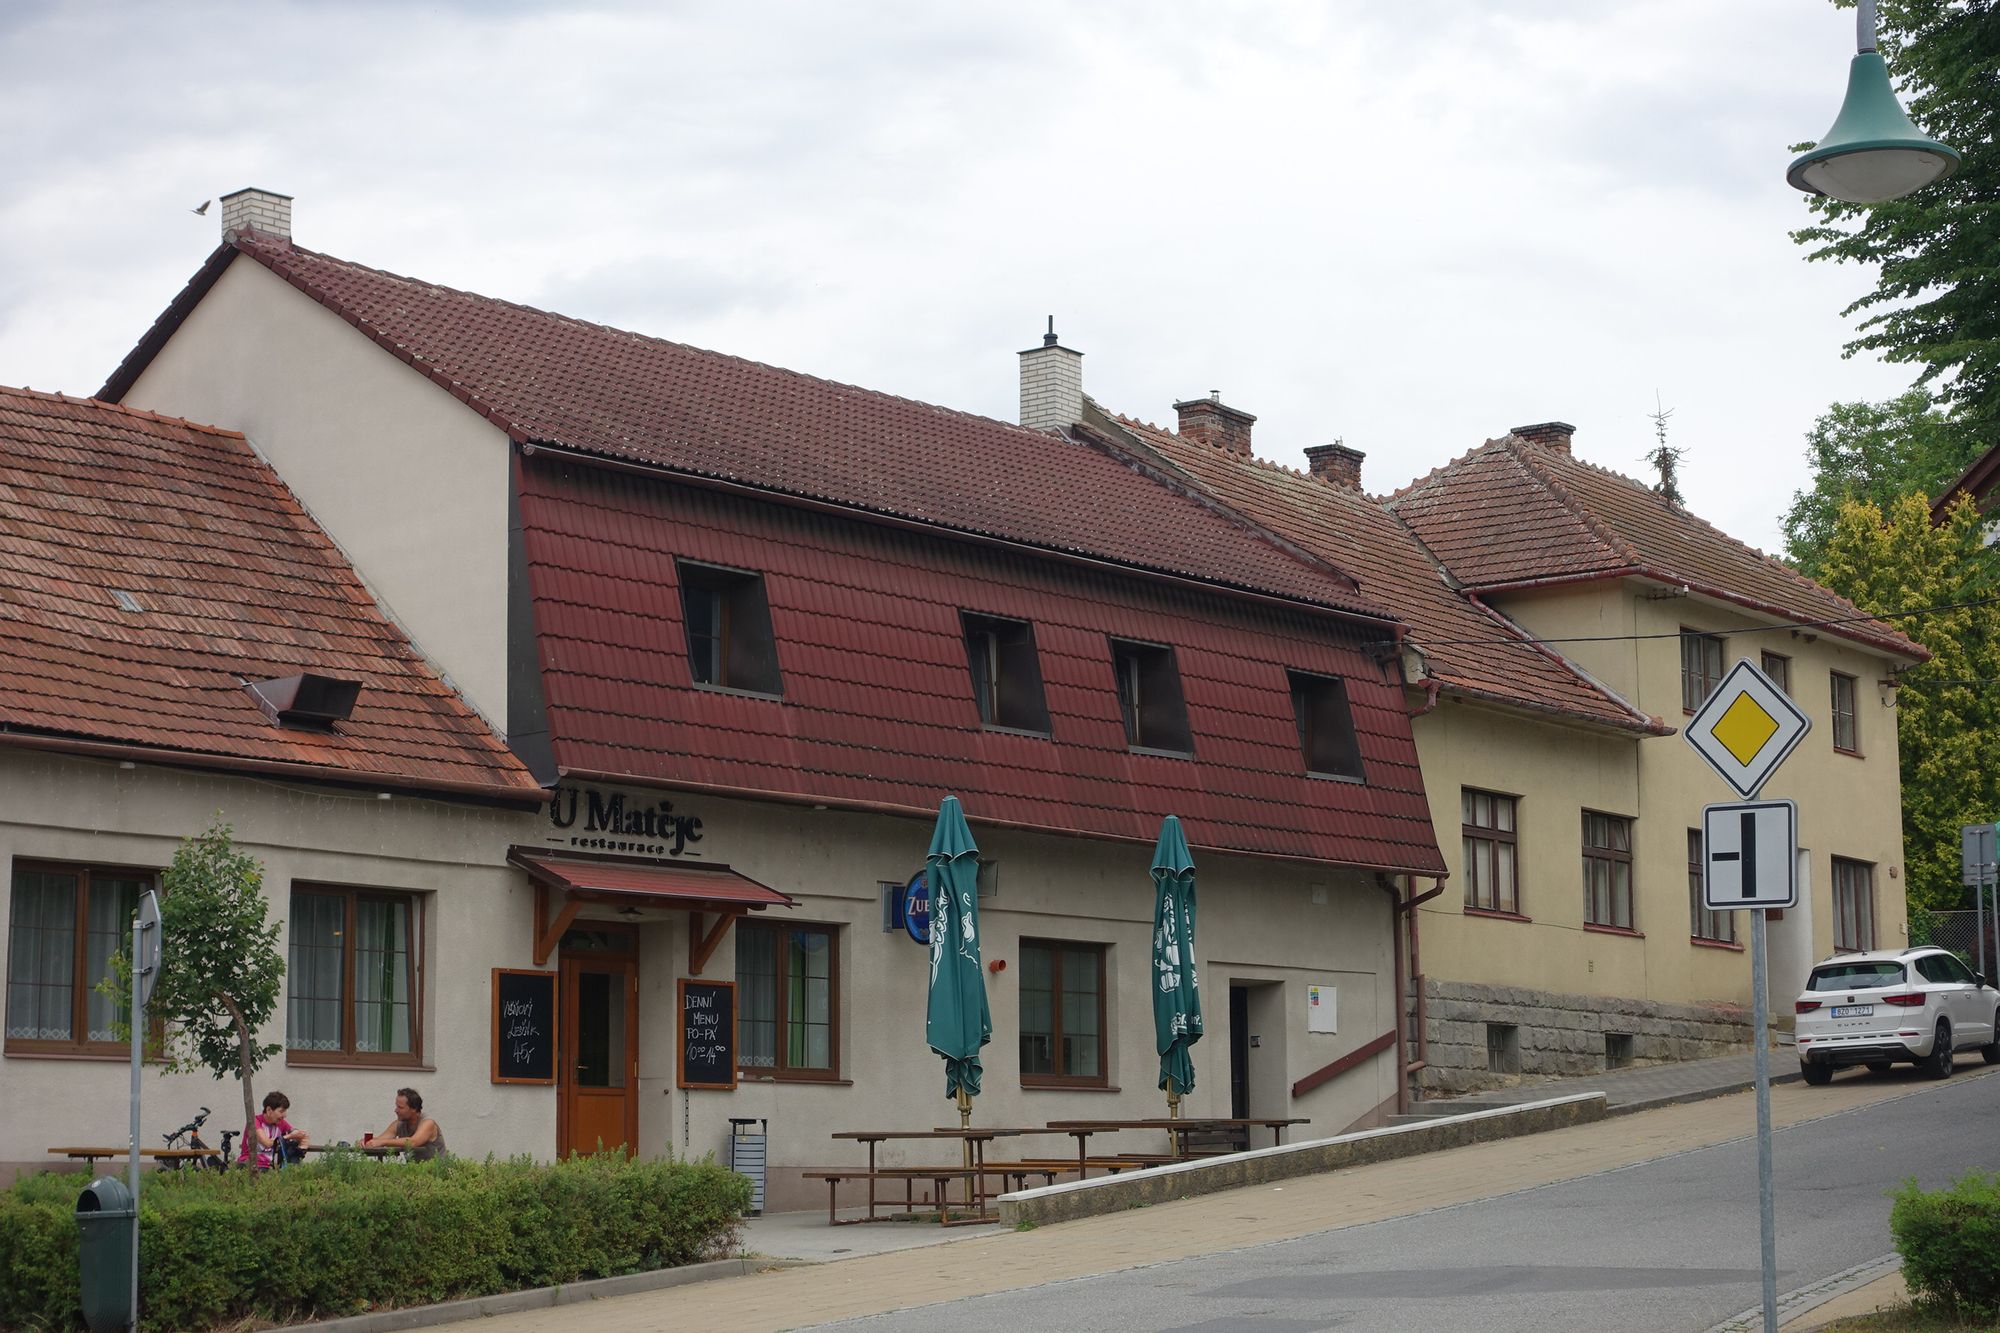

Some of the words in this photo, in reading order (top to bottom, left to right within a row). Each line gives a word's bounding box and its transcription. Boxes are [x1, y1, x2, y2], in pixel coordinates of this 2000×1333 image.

[550, 787, 579, 829] U
[584, 790, 704, 857] Matěje
[571, 836, 665, 854] restaurace
[908, 896, 929, 915] ZUB
[693, 1011, 719, 1026] MENU
[1855, 1006, 1870, 1014] 1271
